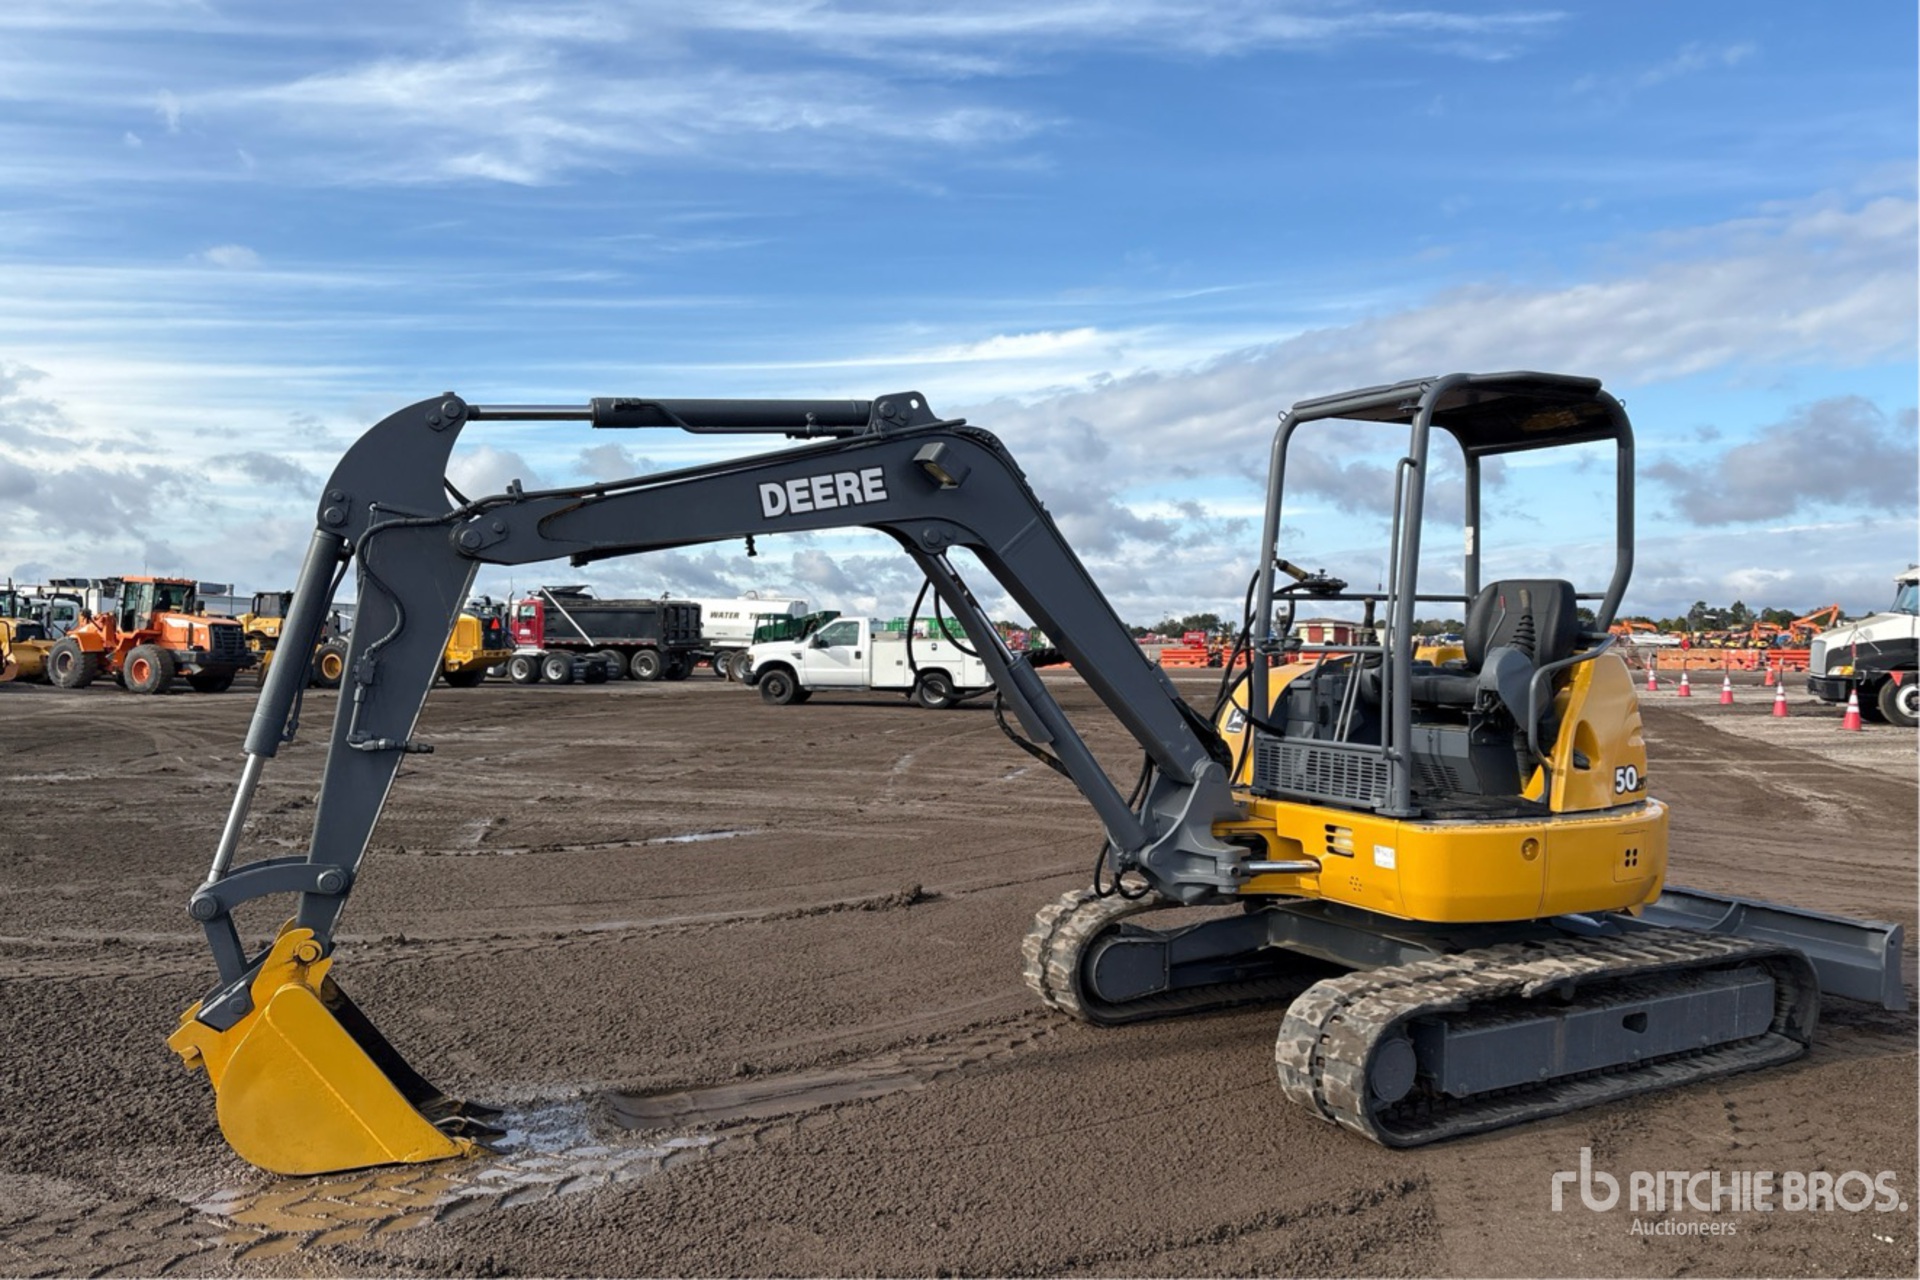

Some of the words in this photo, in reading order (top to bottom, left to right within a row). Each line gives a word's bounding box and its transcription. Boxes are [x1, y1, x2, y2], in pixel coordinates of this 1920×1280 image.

[758, 466, 888, 518] DEERE
[710, 611, 740, 619] WATER
[1615, 764, 1638, 795] 50
